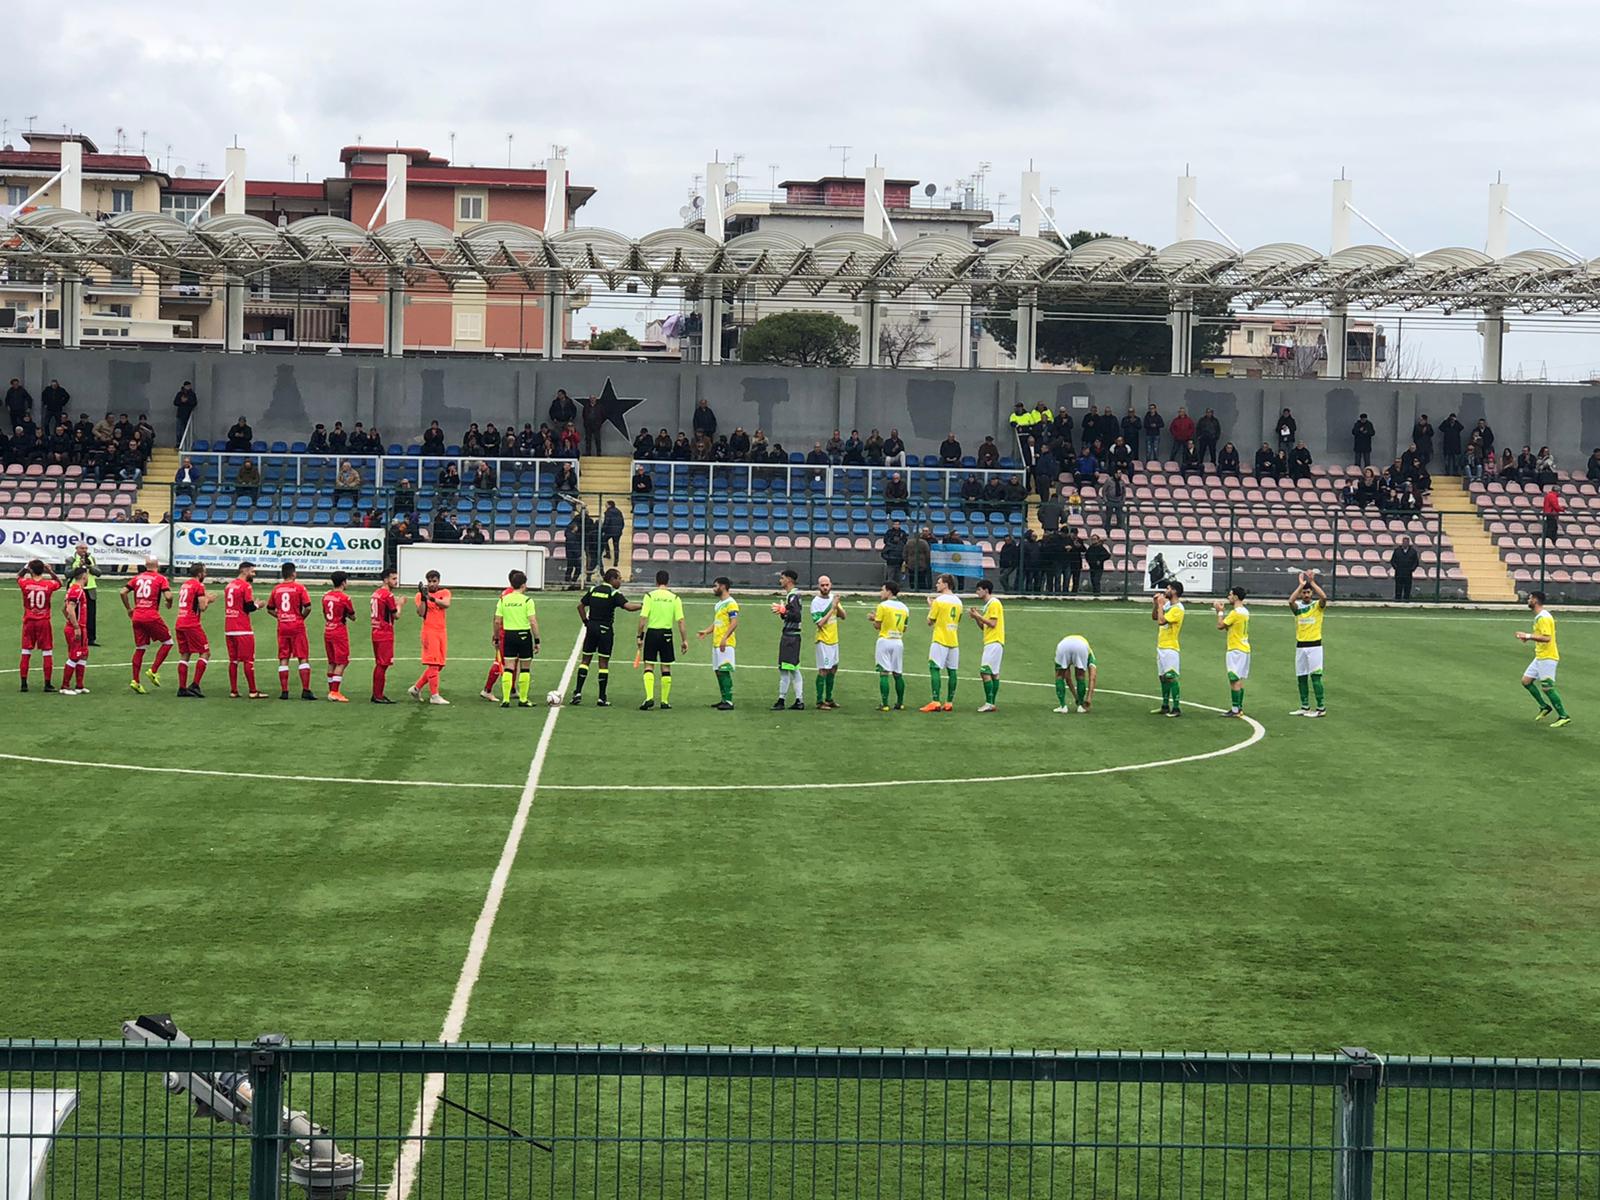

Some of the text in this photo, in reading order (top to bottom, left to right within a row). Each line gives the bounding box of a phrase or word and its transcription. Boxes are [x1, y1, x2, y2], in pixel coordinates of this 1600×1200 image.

[12, 531, 152, 549] D'Angelo Carlo
[260, 547, 269, 555] in
[271, 548, 328, 557] agricoltura
[1186, 551, 1208, 560] Ciao
[1178, 559, 1208, 568] Nicola
[136, 579, 152, 598] 26
[226, 588, 234, 607] 5
[27, 590, 46, 609] 10
[281, 592, 291, 612] 8
[326, 600, 334, 620] 3
[950, 606, 957, 621] 4
[895, 613, 902, 627] 7
